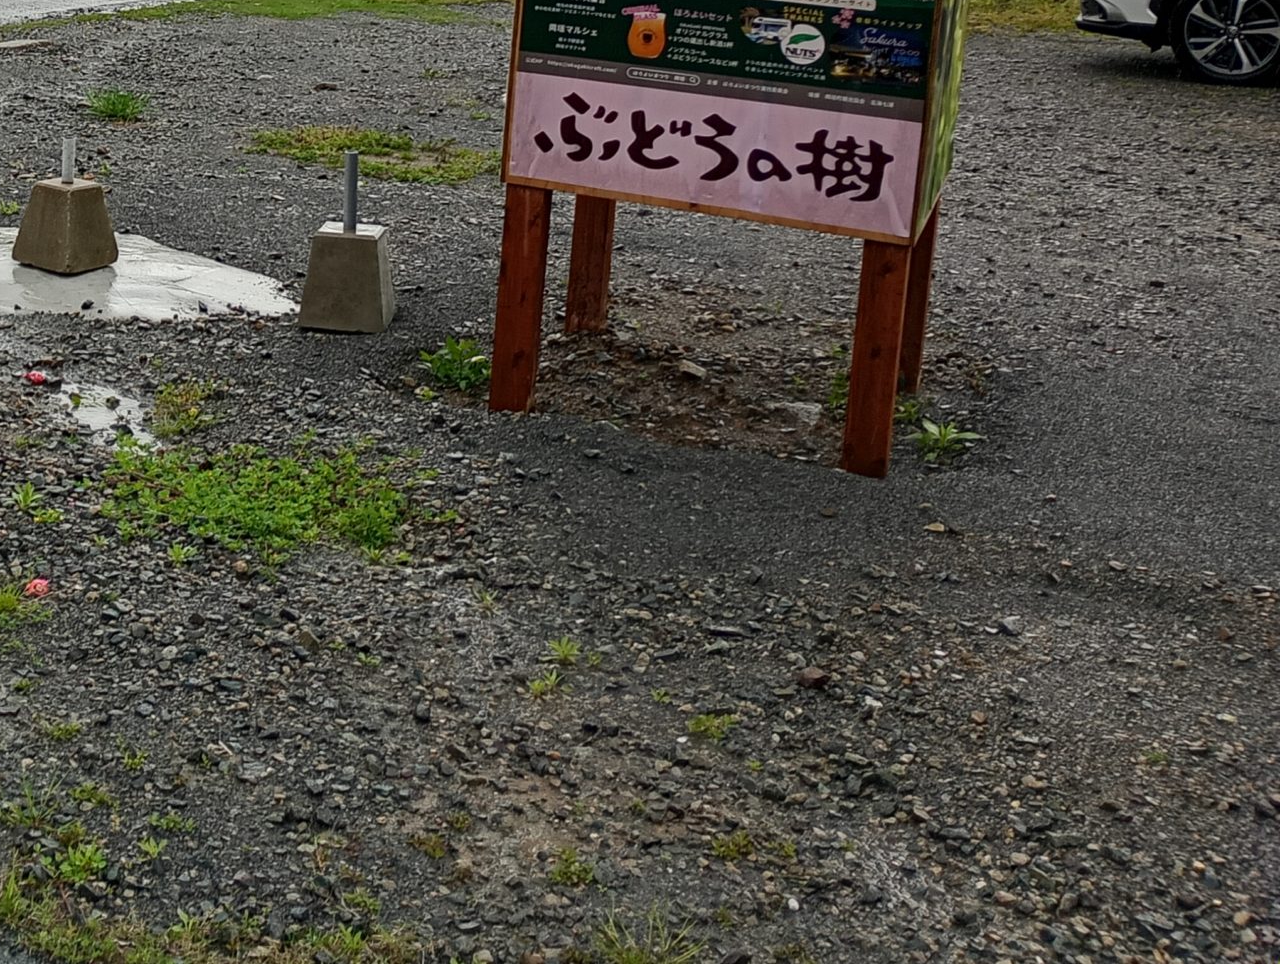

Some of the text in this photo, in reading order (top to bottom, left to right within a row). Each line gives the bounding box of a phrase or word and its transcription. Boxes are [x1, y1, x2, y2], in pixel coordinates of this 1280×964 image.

[859, 27, 909, 47] Sakura
[785, 47, 817, 58] NUTS
[534, 91, 894, 202] ぶどうの樹
